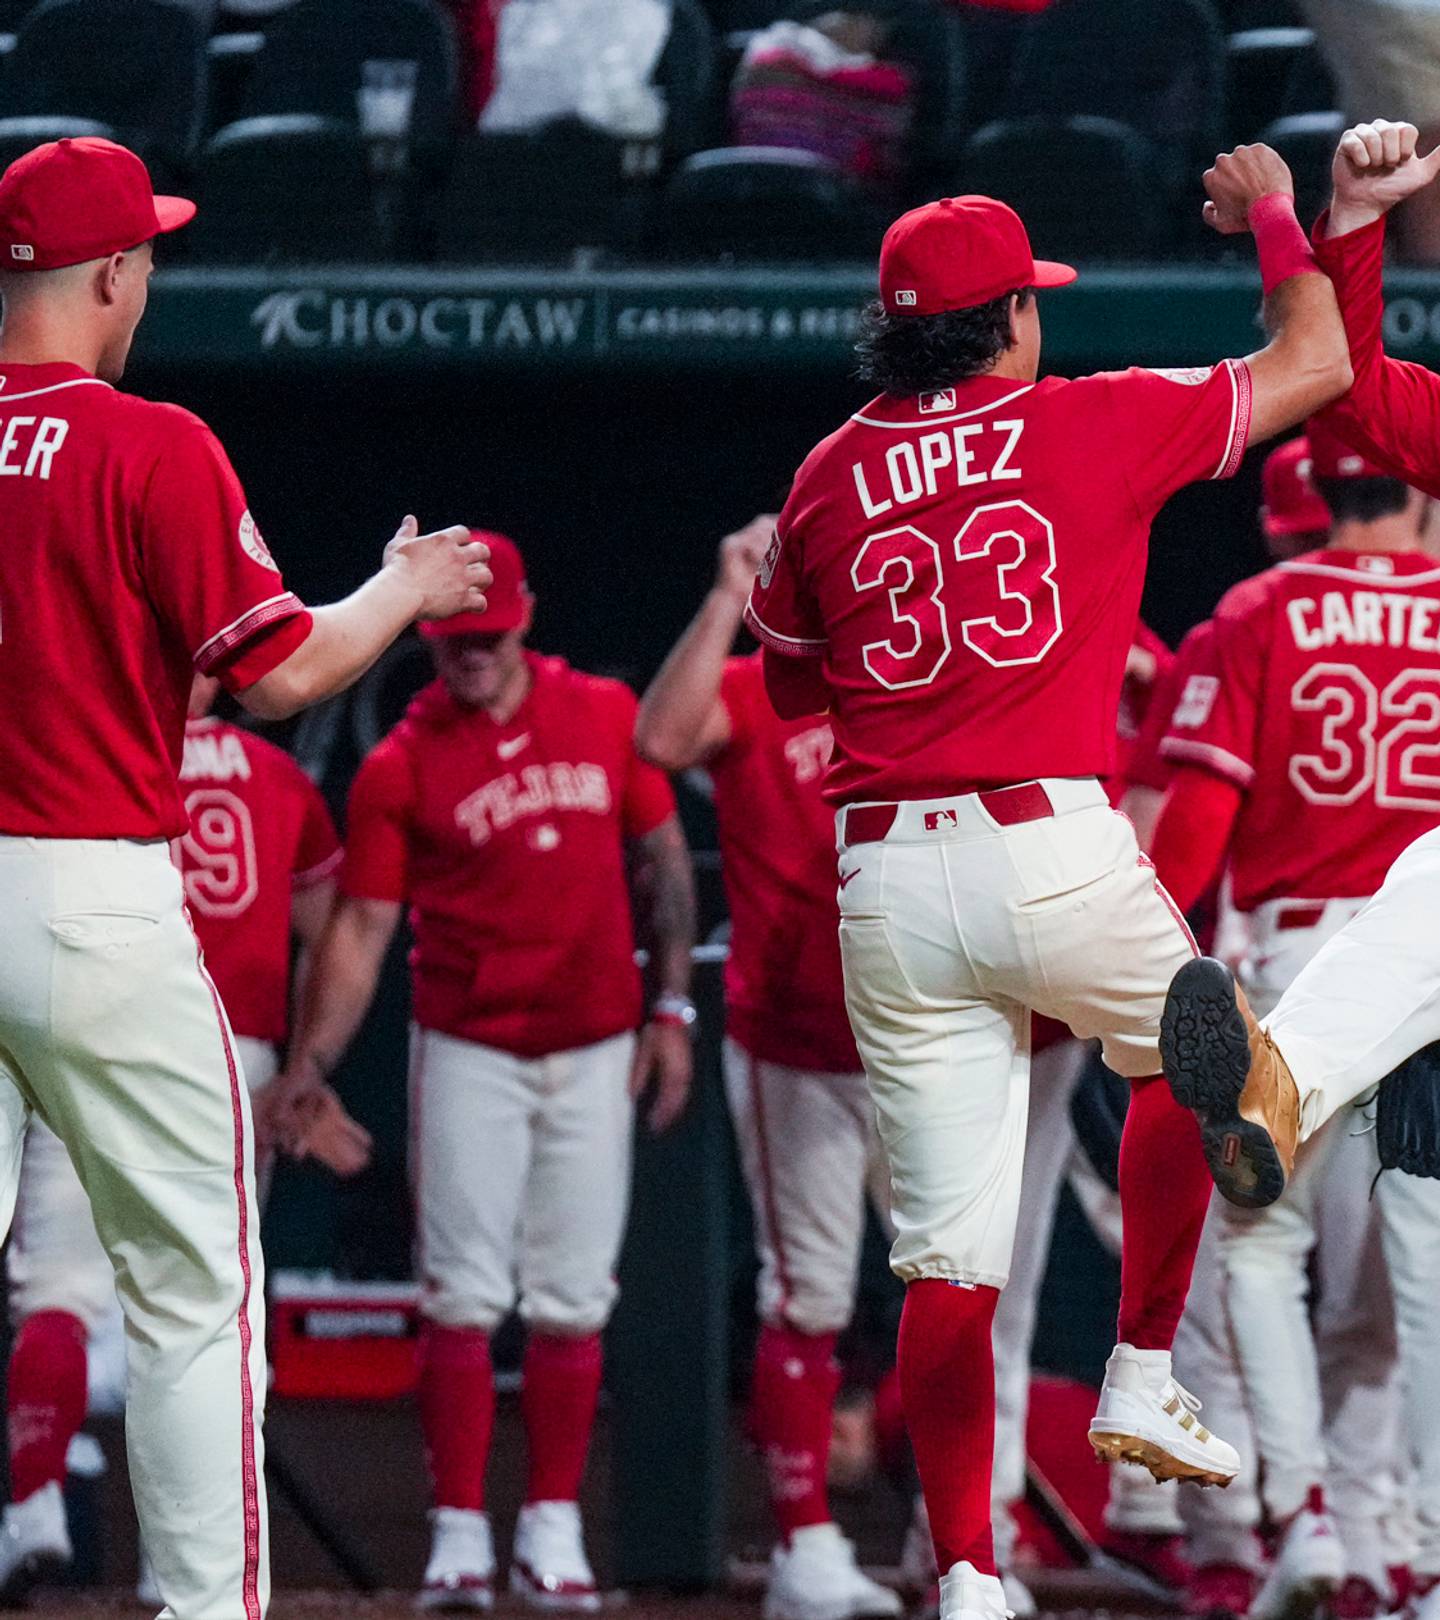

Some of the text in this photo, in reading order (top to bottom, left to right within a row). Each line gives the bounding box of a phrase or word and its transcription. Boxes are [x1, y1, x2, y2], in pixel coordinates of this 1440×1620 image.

[252, 288, 585, 347] CHOCTAW
[852, 418, 1025, 519] LOPEZ
[850, 499, 1064, 691] 33
